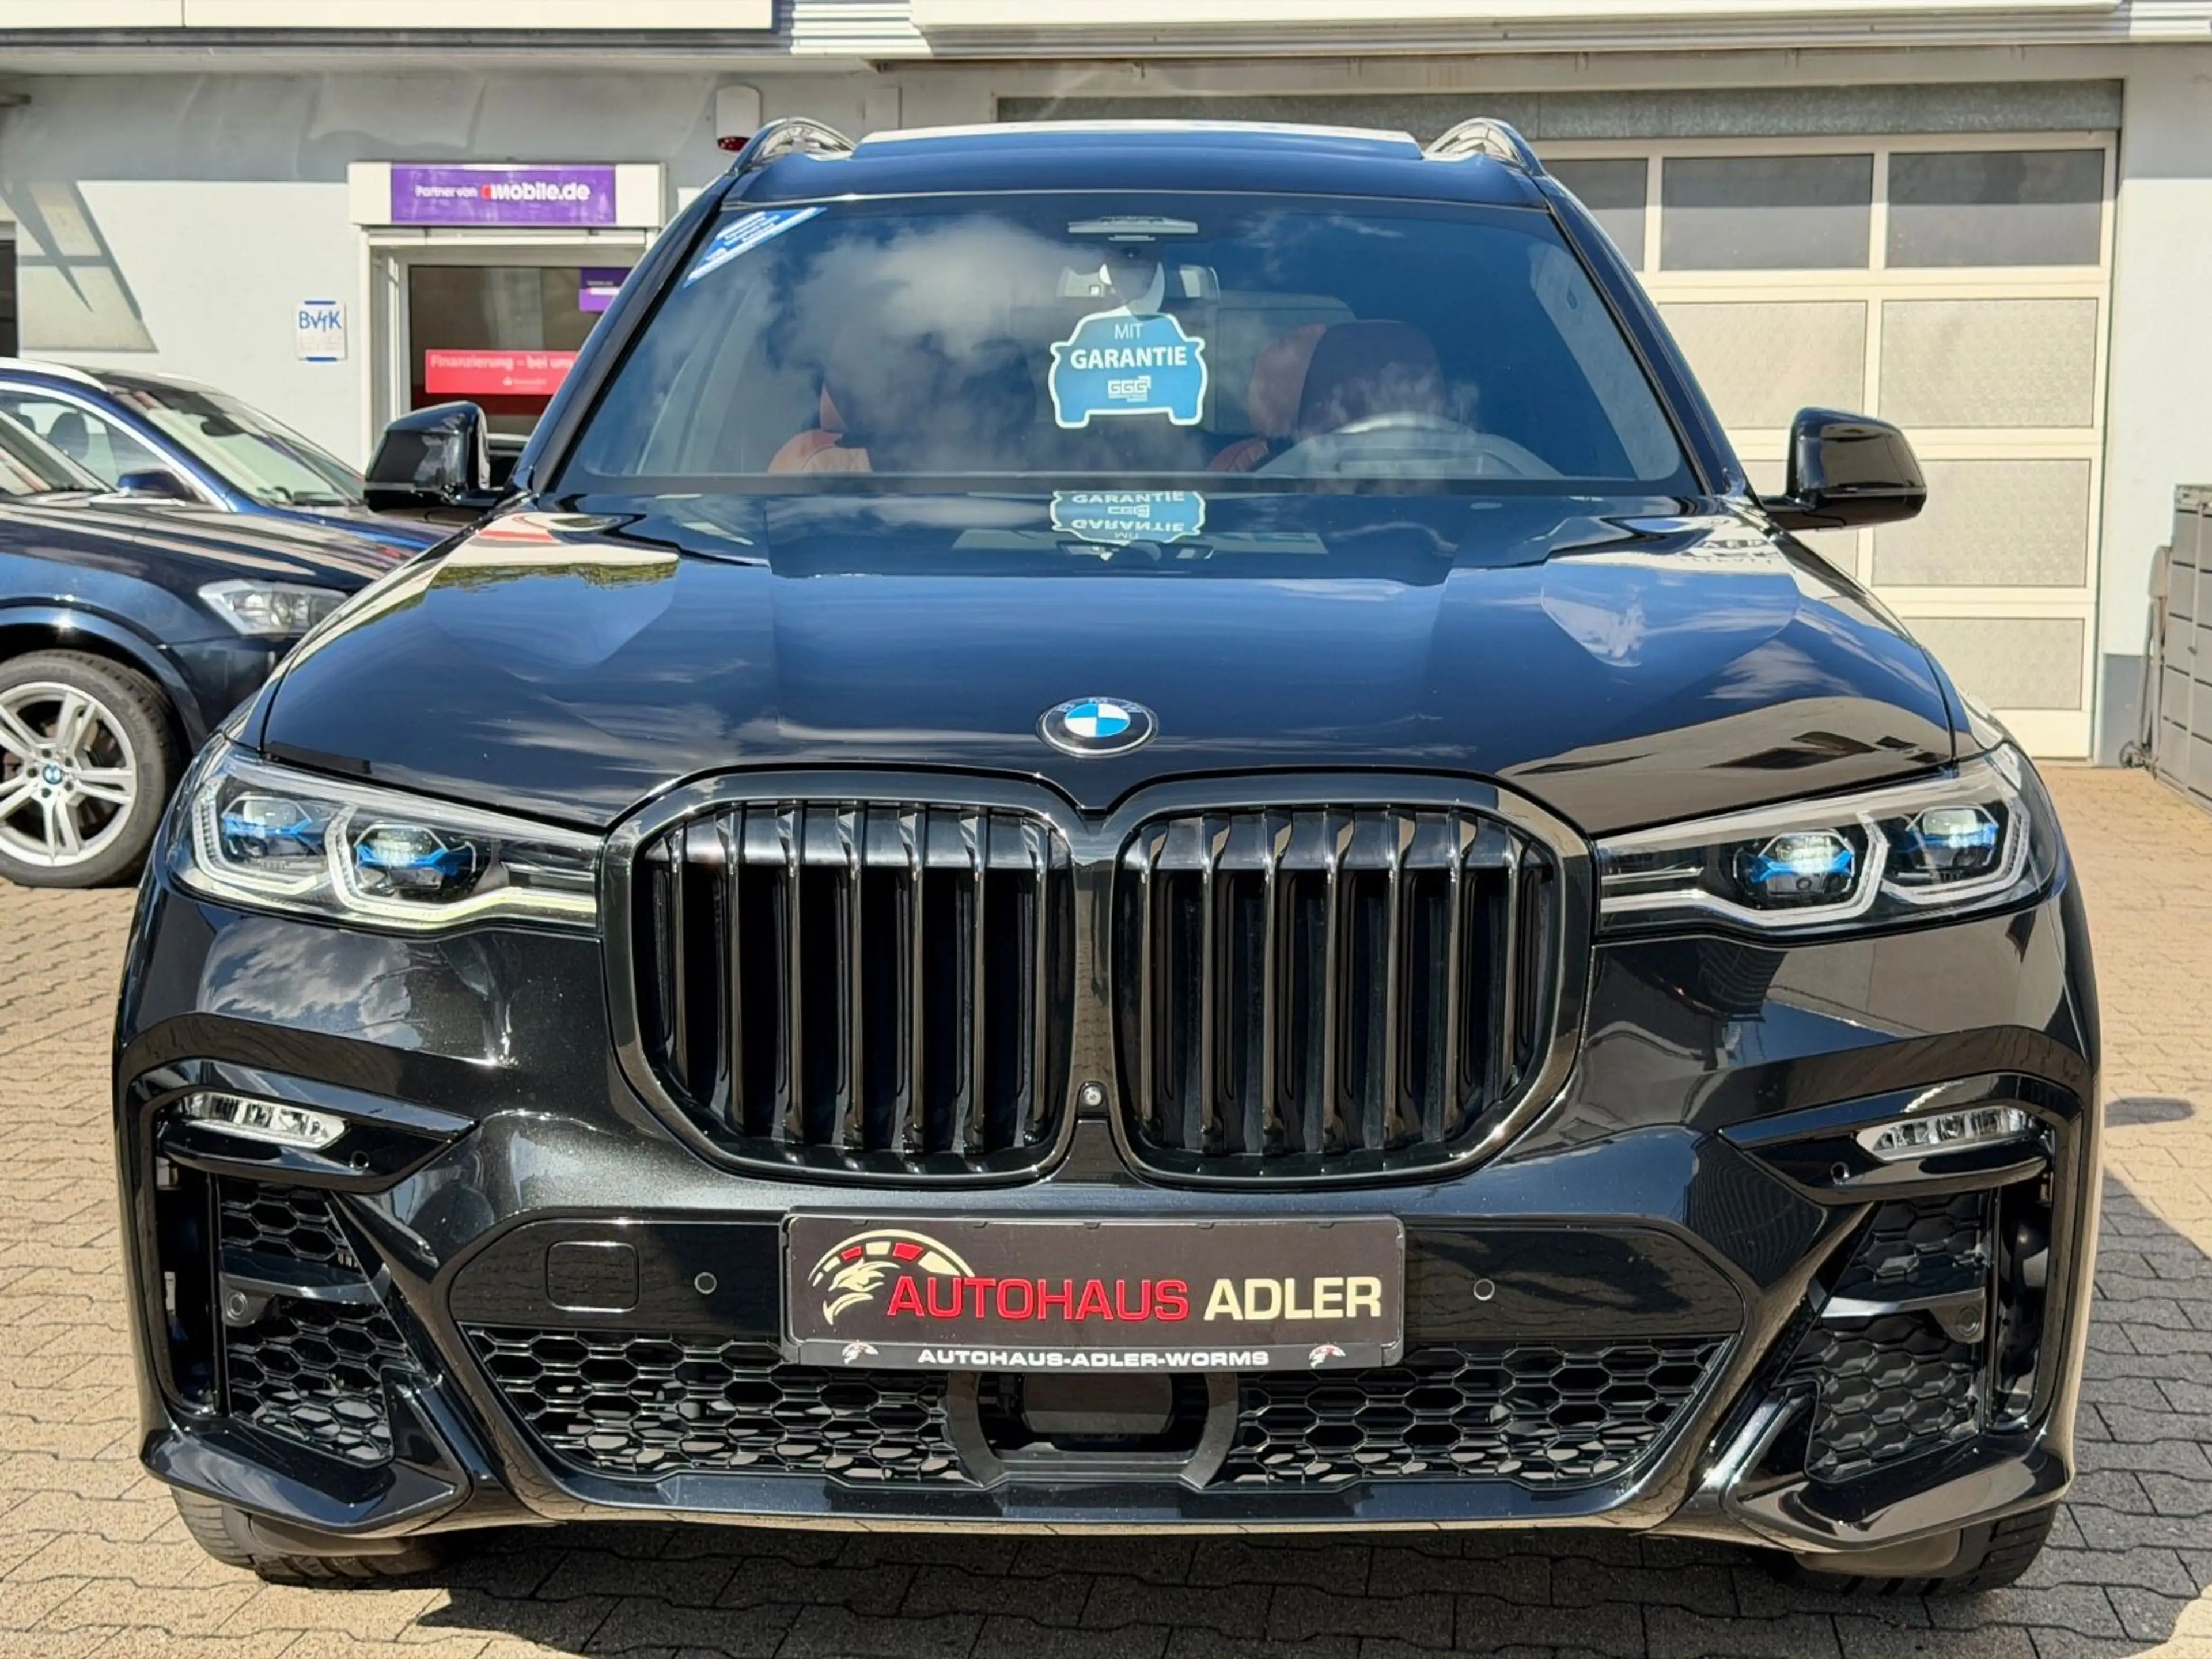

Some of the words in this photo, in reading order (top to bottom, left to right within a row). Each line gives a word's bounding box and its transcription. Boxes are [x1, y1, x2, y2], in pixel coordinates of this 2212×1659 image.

[491, 182, 591, 200] mobile.de
[1114, 323, 1143, 339] MIT
[1070, 346, 1188, 370] GARANTIE
[887, 1275, 1189, 1321] AUTOHAUS
[1203, 1275, 1382, 1321] ADLER
[918, 1349, 1270, 1368] AUTOHAUS-ADLER-WORMS
